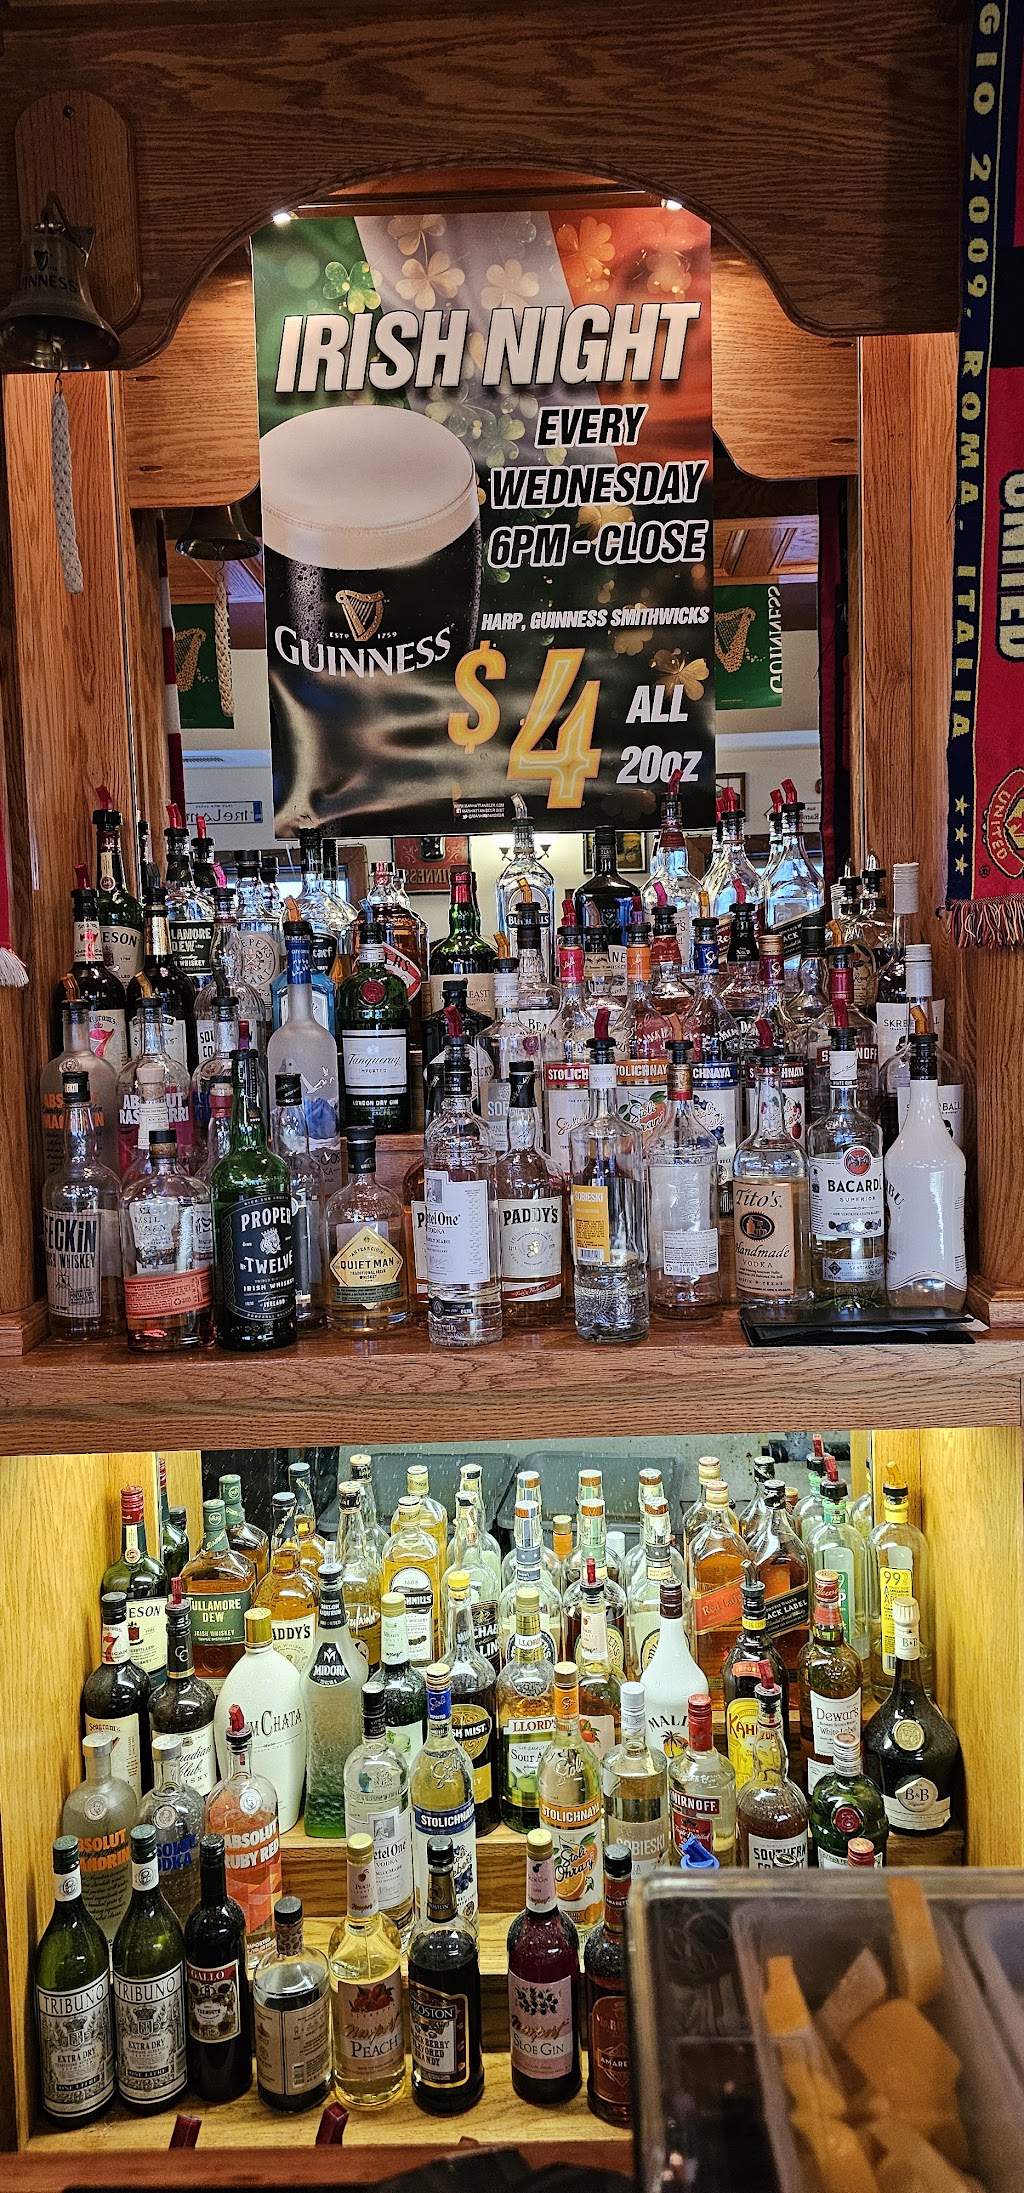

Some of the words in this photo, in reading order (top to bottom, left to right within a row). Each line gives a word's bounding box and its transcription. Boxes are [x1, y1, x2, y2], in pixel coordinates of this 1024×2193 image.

[274, 308, 470, 394] IRISH
[481, 301, 702, 388] NIGHT
[534, 404, 648, 449] EVERY
[490, 460, 708, 510] WEDNESDAY
[487, 525, 571, 568] 6PM
[594, 519, 710, 567] CLOSE
[481, 612, 527, 632] HARP,
[530, 610, 607, 629] GUINNESS
[610, 606, 710, 627] SMITHWICKS
[376, 630, 398, 640] 1759
[274, 625, 452, 678] GUINNESS
[952, 565, 977, 740] ITALIA
[625, 685, 689, 724] ALL
[102, 930, 138, 947] ESON
[171, 928, 211, 940] LAMORE
[783, 932, 798, 942] ACK
[347, 1053, 402, 1067] Tanqueray
[822, 1048, 877, 1062] SNOFF
[548, 1067, 589, 1080] STOLICH
[692, 1066, 731, 1079] CHNAYA
[574, 1191, 604, 1203] SOBIESKI
[241, 1207, 291, 1232] PROPER
[438, 1212, 459, 1226] One
[503, 1205, 559, 1226] PADDY'S
[735, 1241, 790, 1258] Handmade
[59, 1253, 96, 1269] WHISKEY
[244, 1250, 293, 1274] TWELVE
[340, 1260, 371, 1270] QUIET
[374, 1257, 394, 1268] MAN
[743, 1259, 773, 1268] VODKA
[243, 1284, 266, 1292] IRISH
[129, 1606, 161, 1618] ESON
[202, 1611, 224, 1623] DEW
[703, 1601, 721, 1616] Red
[766, 1608, 783, 1622] ACK
[783, 1599, 808, 1617] LABEL
[271, 1623, 311, 1640] ADDY'S
[313, 1664, 345, 1677] MIDORI
[816, 1706, 859, 1722] Dewar's
[649, 1714, 687, 1732] MALI
[820, 1724, 839, 1736] White
[511, 1749, 536, 1762] Sour
[79, 1827, 127, 1850] BSOLUT
[224, 1821, 278, 1850] ABSOLUT
[157, 1833, 196, 1857] SOLUT
[261, 1842, 279, 1863] RED
[373, 1846, 388, 1860] etel
[390, 1840, 407, 1856] One
[80, 1850, 131, 1872] ANDRIN
[158, 1853, 192, 1872] ODKA
[561, 1848, 588, 1868] Stoli
[190, 1970, 225, 1981] GALLO
[117, 1976, 176, 2002] TRIBUNO
[44, 1983, 105, 2014] TRIBUNO
[414, 2004, 454, 2020] BOSTON
[128, 2040, 150, 2050] EXTRA
[151, 2037, 165, 2048] DRY
[351, 2036, 398, 2058] PEACH
[513, 2033, 538, 2055] SLOE
[540, 2043, 564, 2056] GIN
[57, 2053, 81, 2064] EXTRA
[82, 2047, 96, 2060] DRY
[600, 2058, 628, 2068] AMARE
